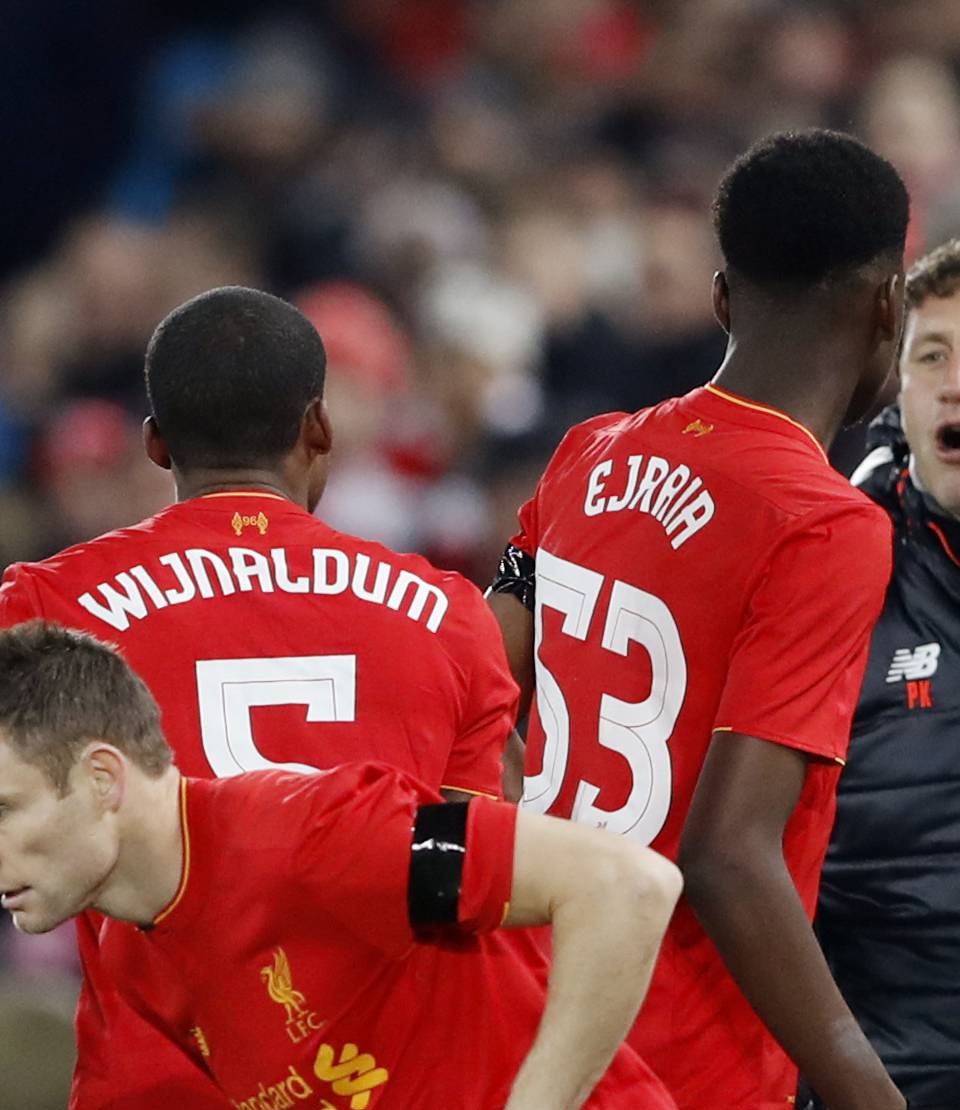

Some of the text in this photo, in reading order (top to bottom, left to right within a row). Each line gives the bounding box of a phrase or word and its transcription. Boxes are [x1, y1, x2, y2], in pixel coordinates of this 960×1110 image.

[242, 515, 258, 526] 96
[583, 454, 716, 550] EJARIA
[77, 547, 450, 634] WIJNALDUM
[522, 546, 688, 848] 53
[906, 680, 933, 709] PK
